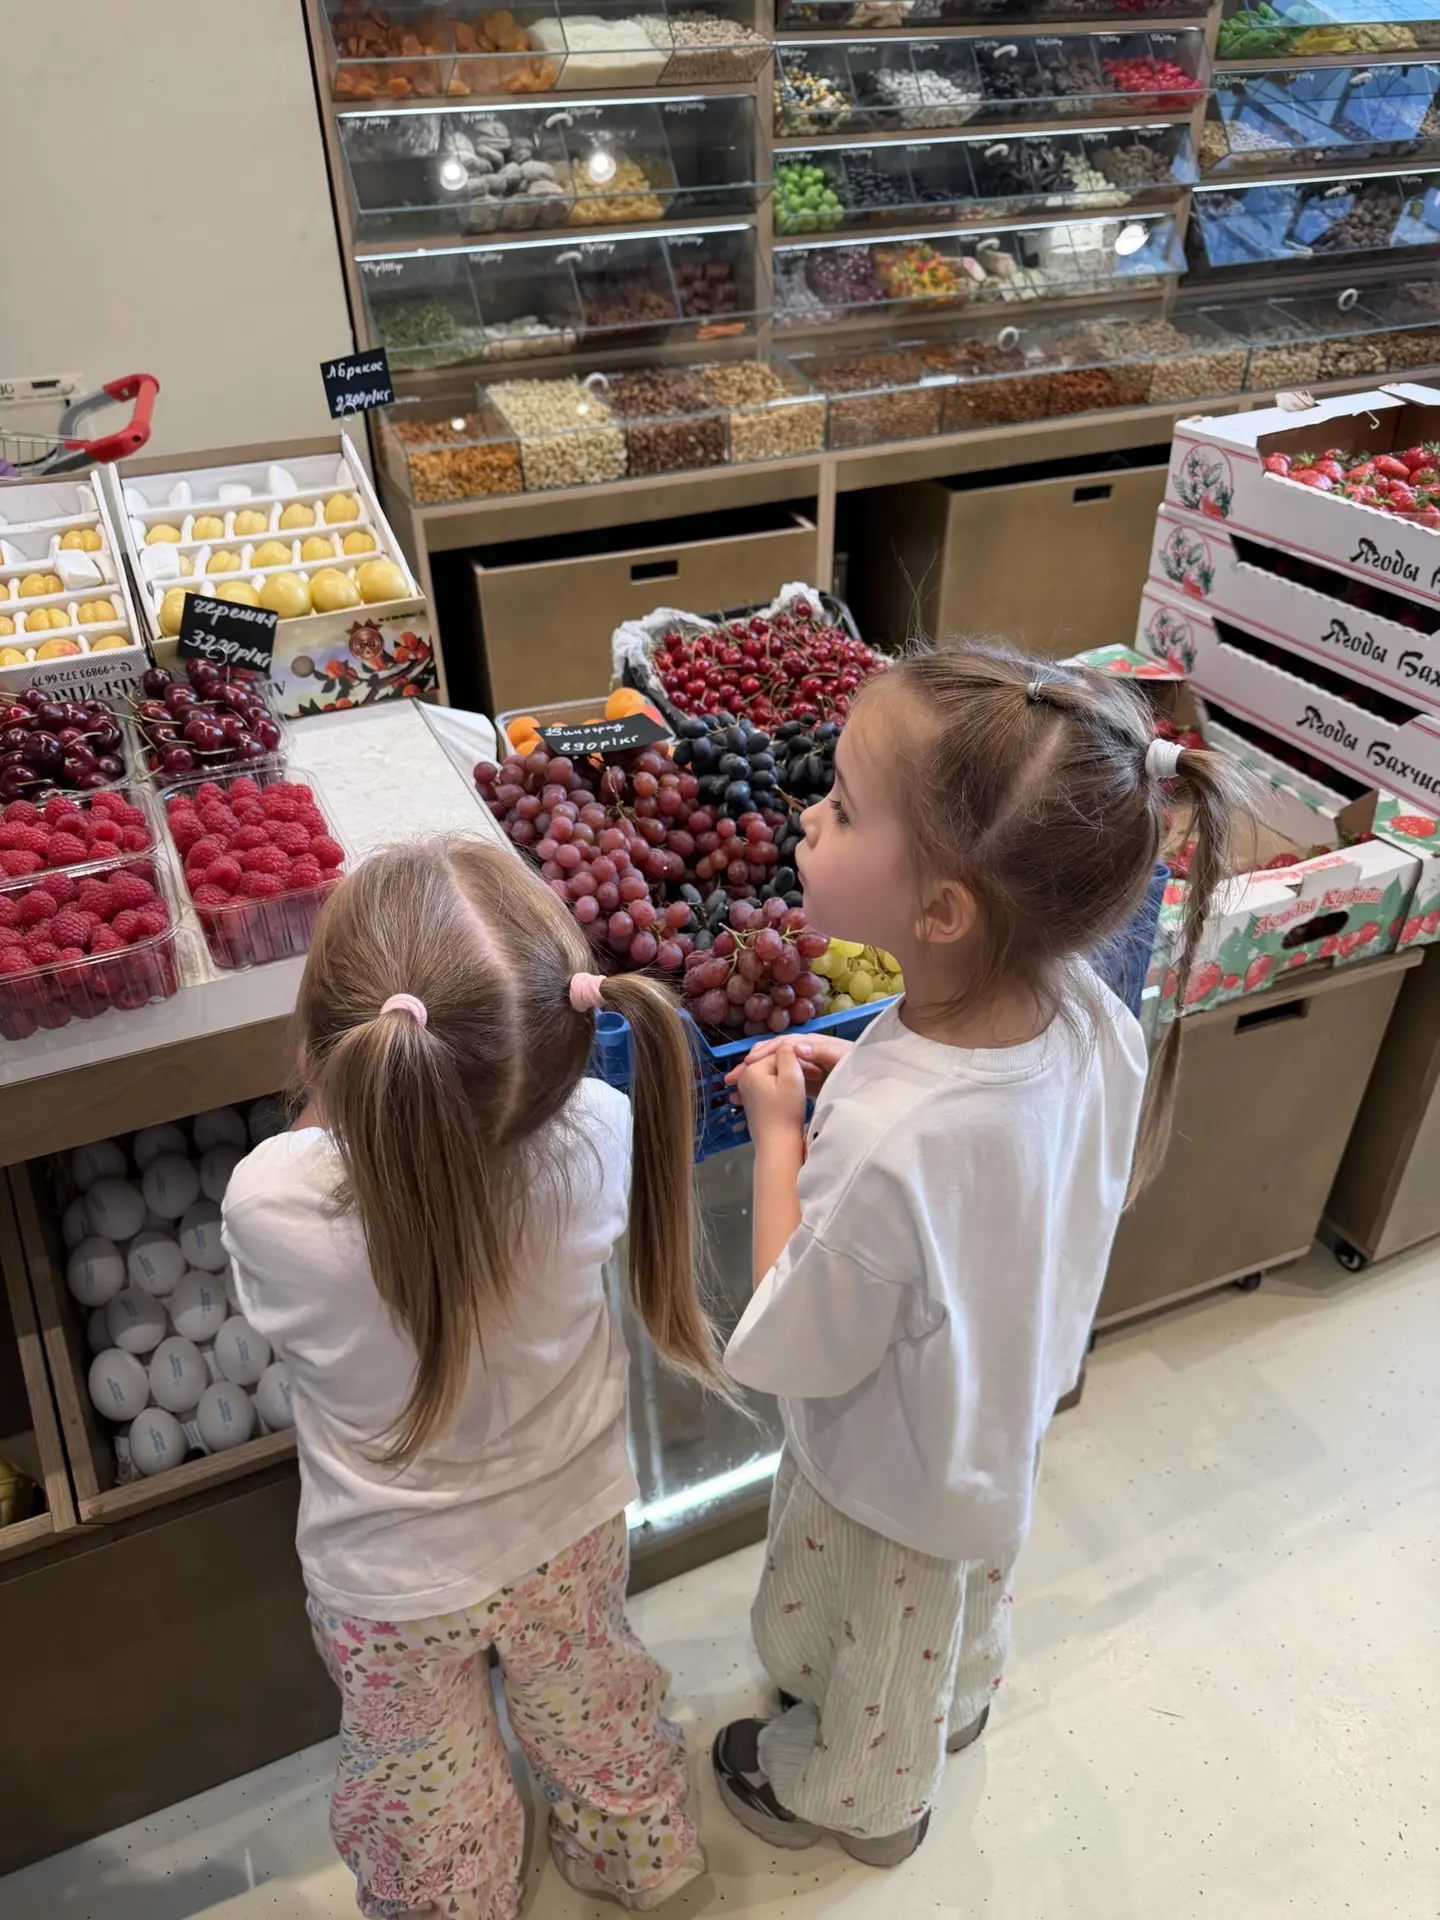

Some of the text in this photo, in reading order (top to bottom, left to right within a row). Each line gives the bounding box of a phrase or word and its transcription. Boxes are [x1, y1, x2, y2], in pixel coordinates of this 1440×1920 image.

[1349, 537, 1420, 582] Ягоды
[1320, 618, 1388, 663] Ягоды
[60, 671, 78, 682] 372
[79, 664, 118, 678] +99893
[44, 673, 58, 685] 66
[544, 722, 625, 737] Виноград
[1296, 705, 1358, 751] Ягоды
